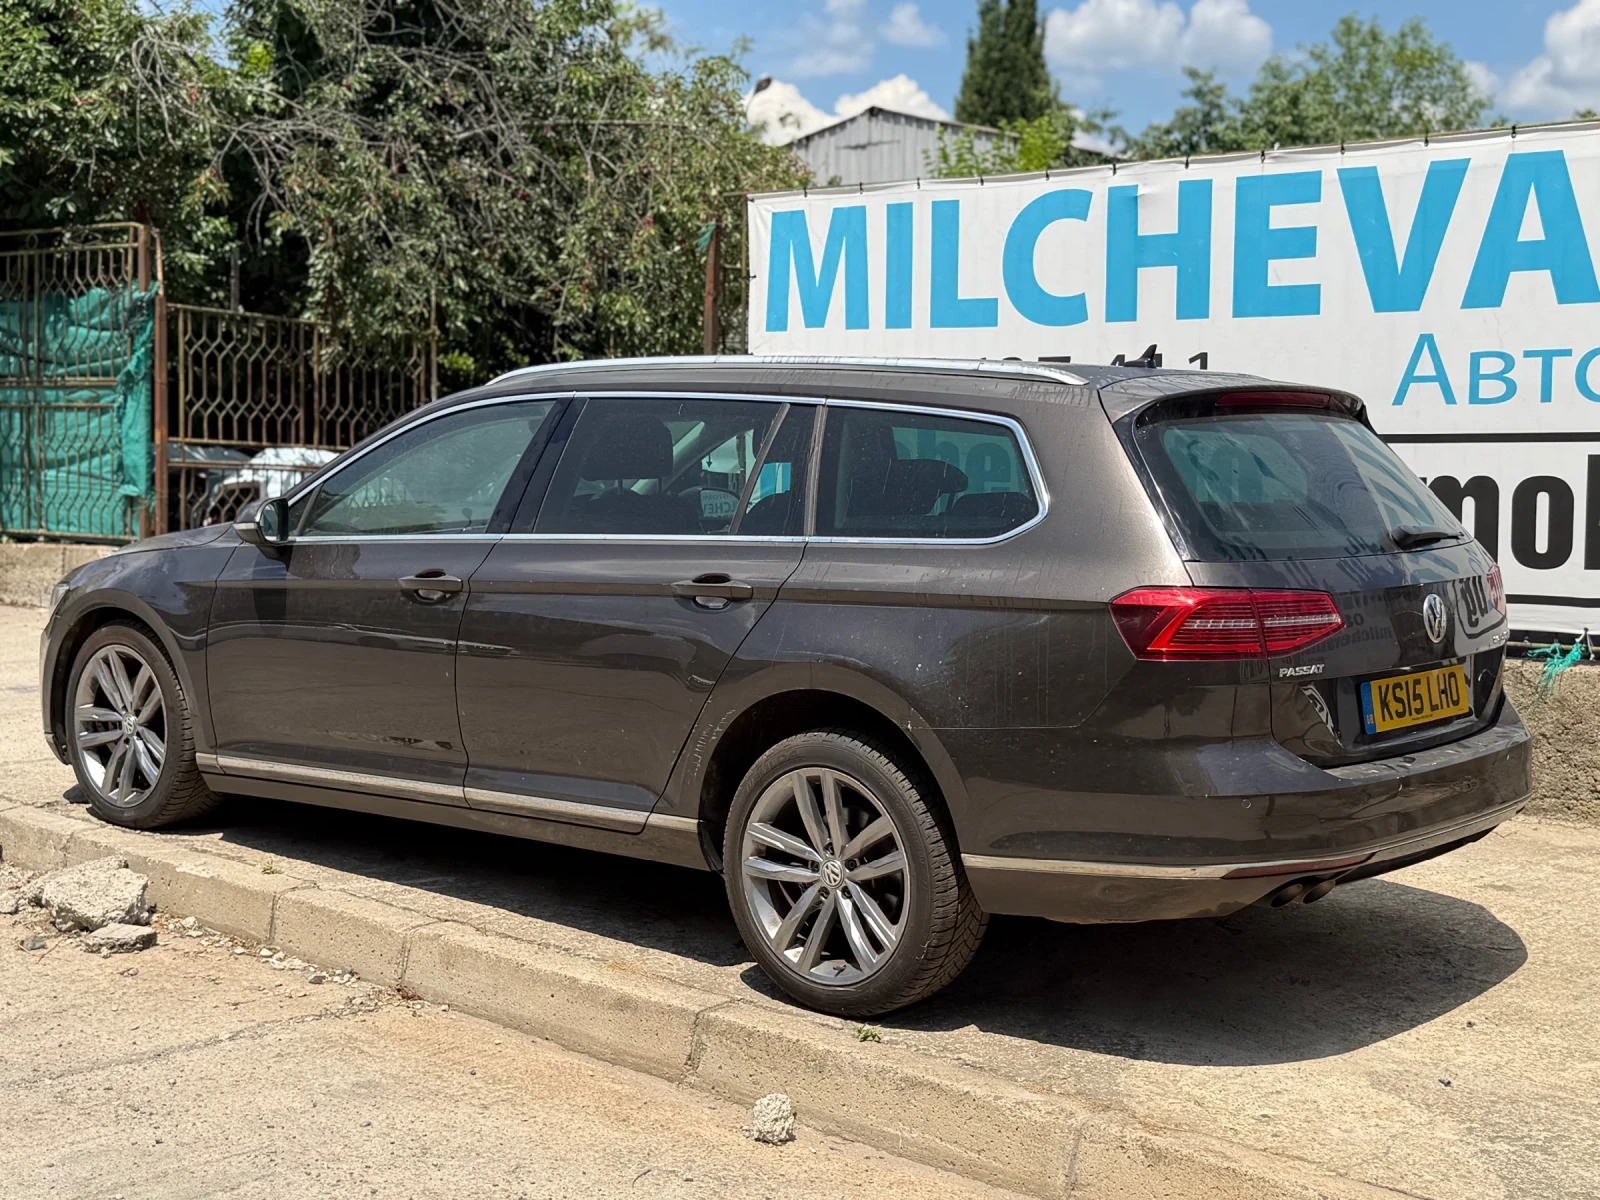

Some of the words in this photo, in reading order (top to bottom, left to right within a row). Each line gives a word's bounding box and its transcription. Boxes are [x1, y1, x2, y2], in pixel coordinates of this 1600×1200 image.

[765, 149, 1600, 333] MILCHEVA
[1279, 663, 1325, 678] PASSAT
[1378, 678, 1425, 722] KS15
[1426, 671, 1461, 712] LHO
